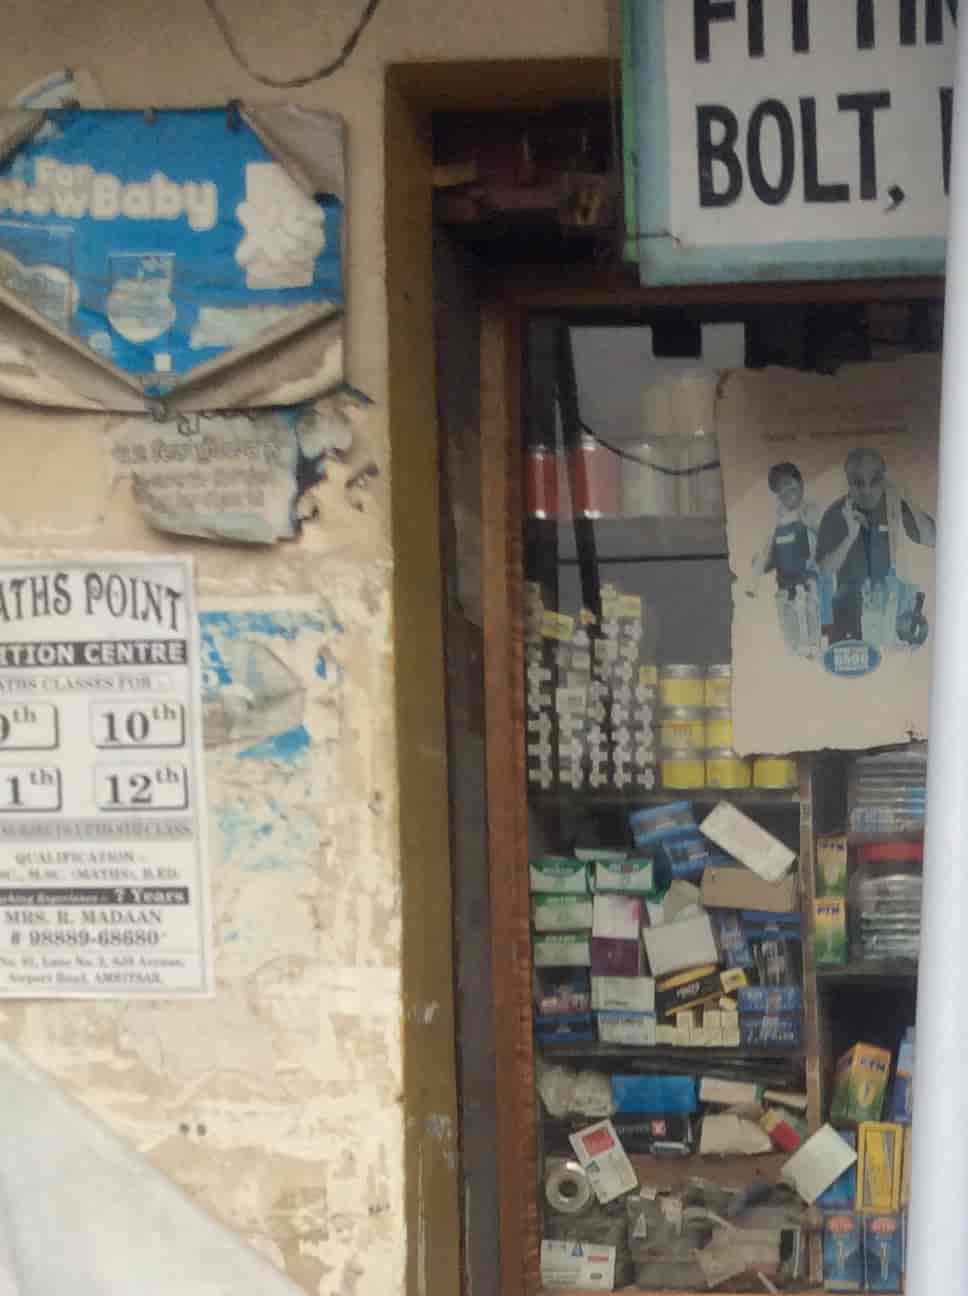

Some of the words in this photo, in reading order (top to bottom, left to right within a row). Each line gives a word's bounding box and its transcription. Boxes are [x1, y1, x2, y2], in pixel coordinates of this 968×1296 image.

[696, 90, 905, 213] BOLT,
[84, 572, 182, 632] POINT
[84, 642, 184, 664] CENTRE
[101, 704, 176, 742] 10th
[106, 766, 180, 805] 12th
